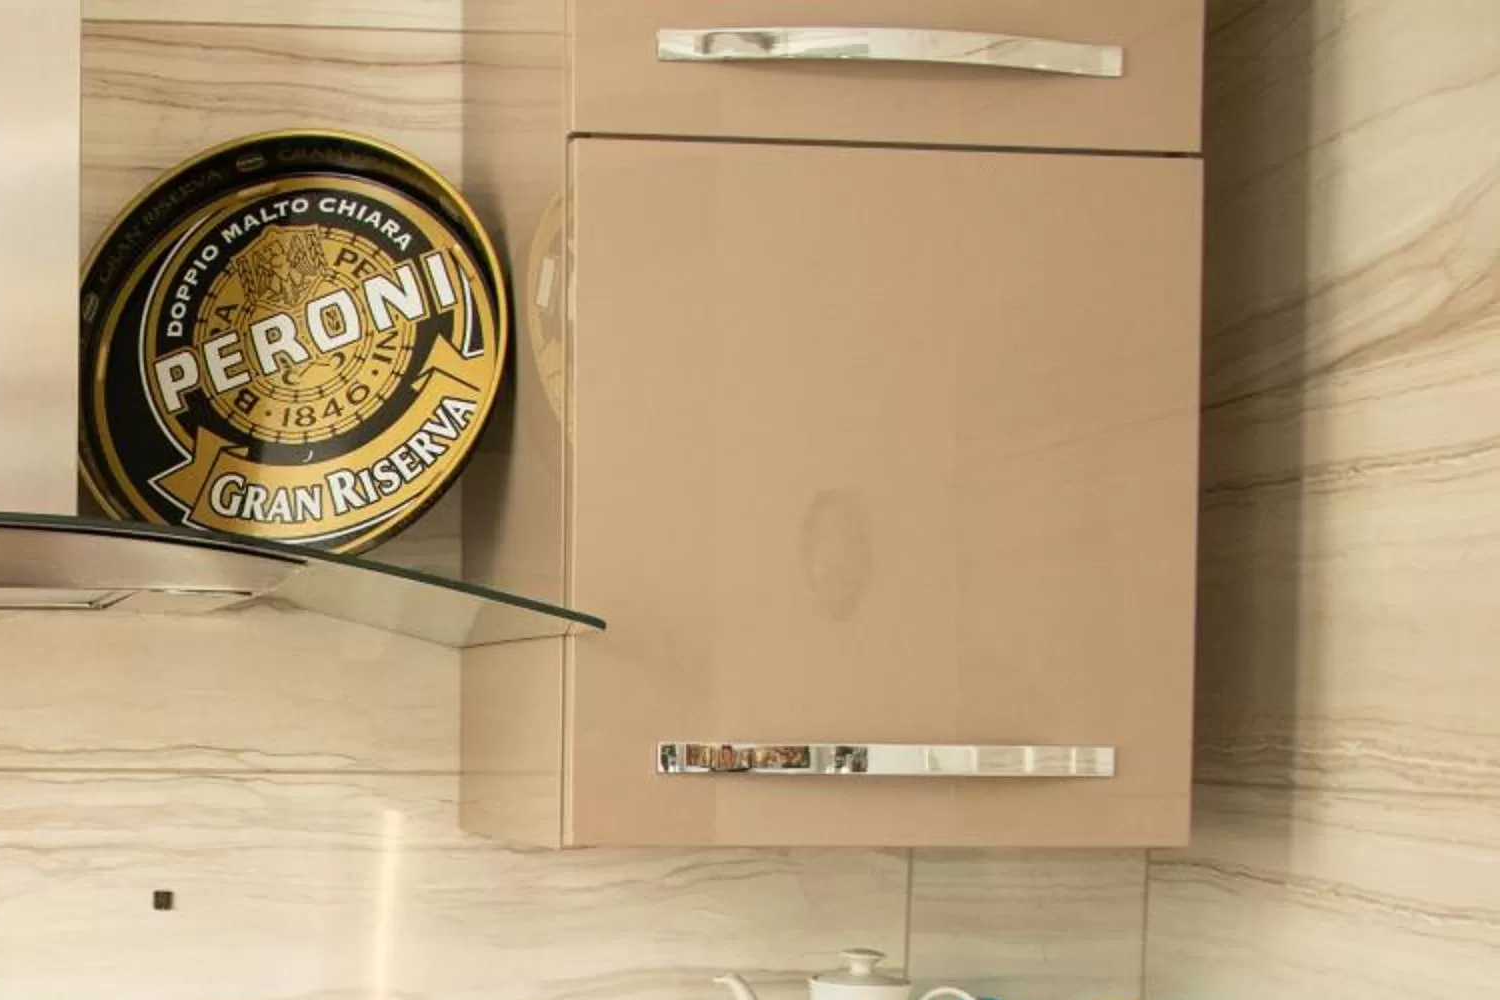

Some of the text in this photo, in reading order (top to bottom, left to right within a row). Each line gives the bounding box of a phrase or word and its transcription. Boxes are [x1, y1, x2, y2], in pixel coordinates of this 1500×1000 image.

[154, 251, 458, 415] PERONI
[167, 197, 413, 337] DOPPIO MALTO CHIARA
[209, 396, 479, 525] GRAN RISERVA
[281, 384, 370, 427] 1846
